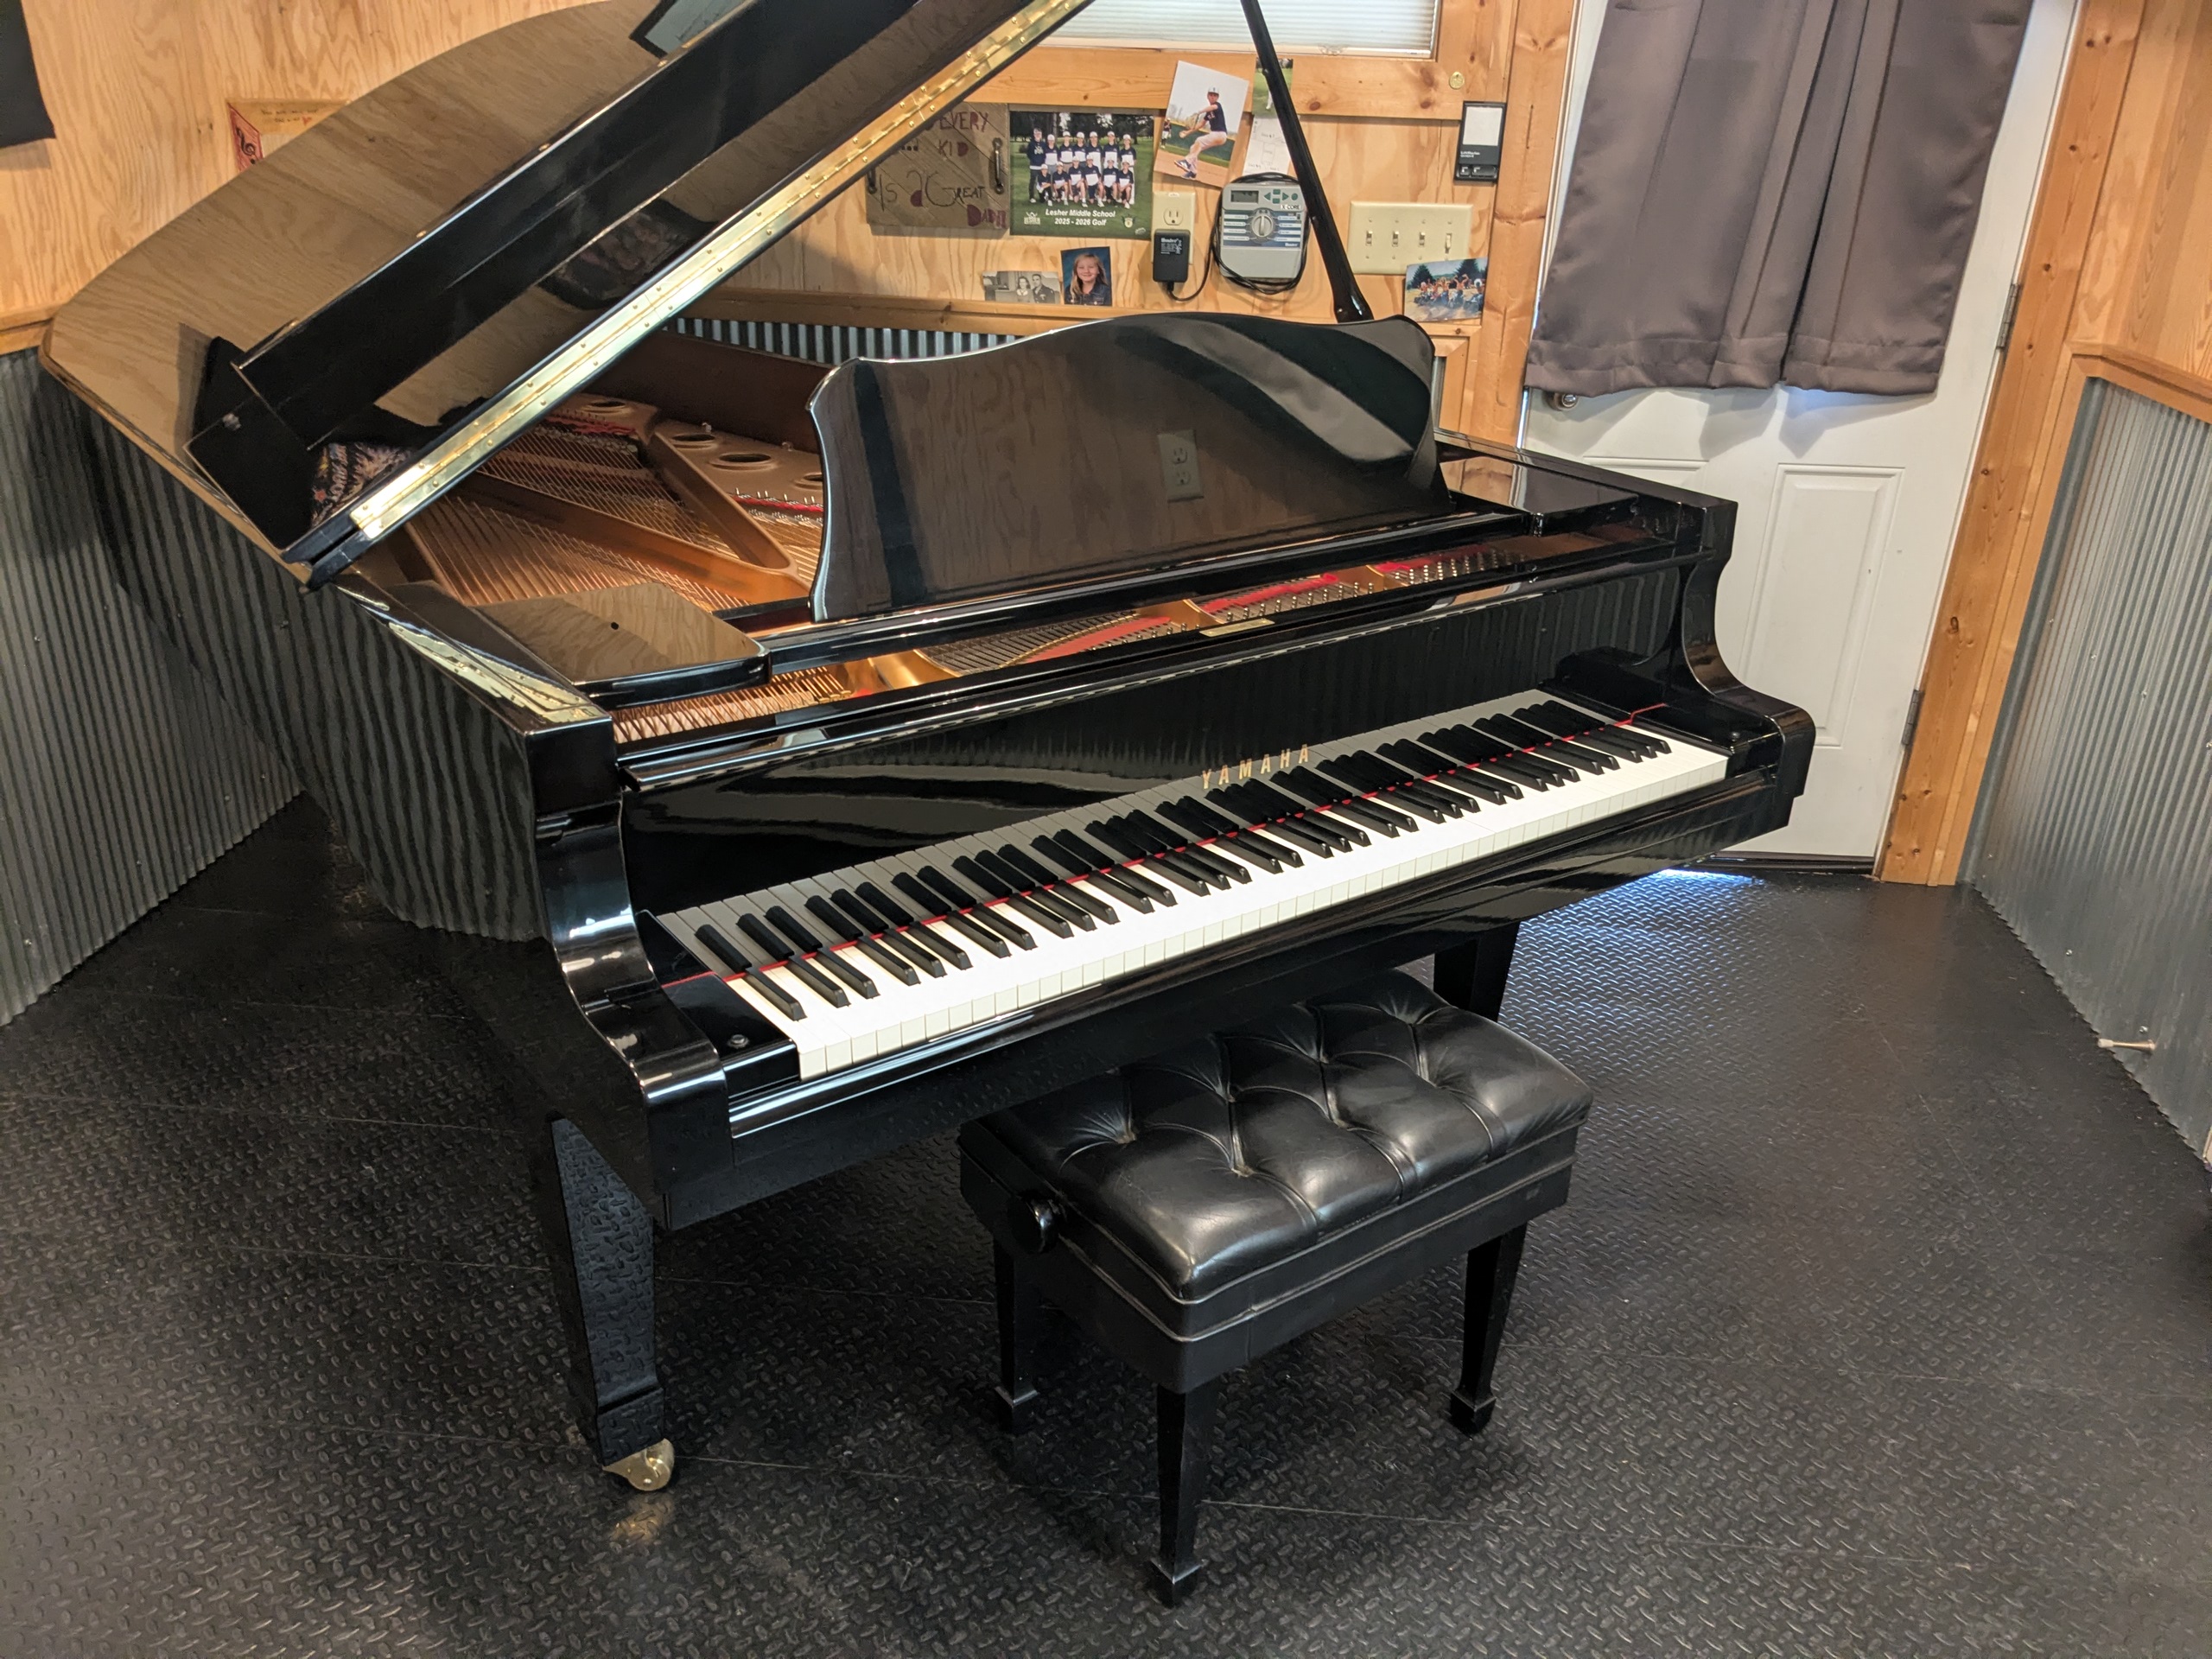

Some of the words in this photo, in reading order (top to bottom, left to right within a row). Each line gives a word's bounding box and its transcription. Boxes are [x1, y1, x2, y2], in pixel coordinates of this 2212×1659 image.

[939, 111, 988, 132] EVERY
[938, 139, 969, 157] KID
[1202, 743, 1309, 790] YAMAHA
